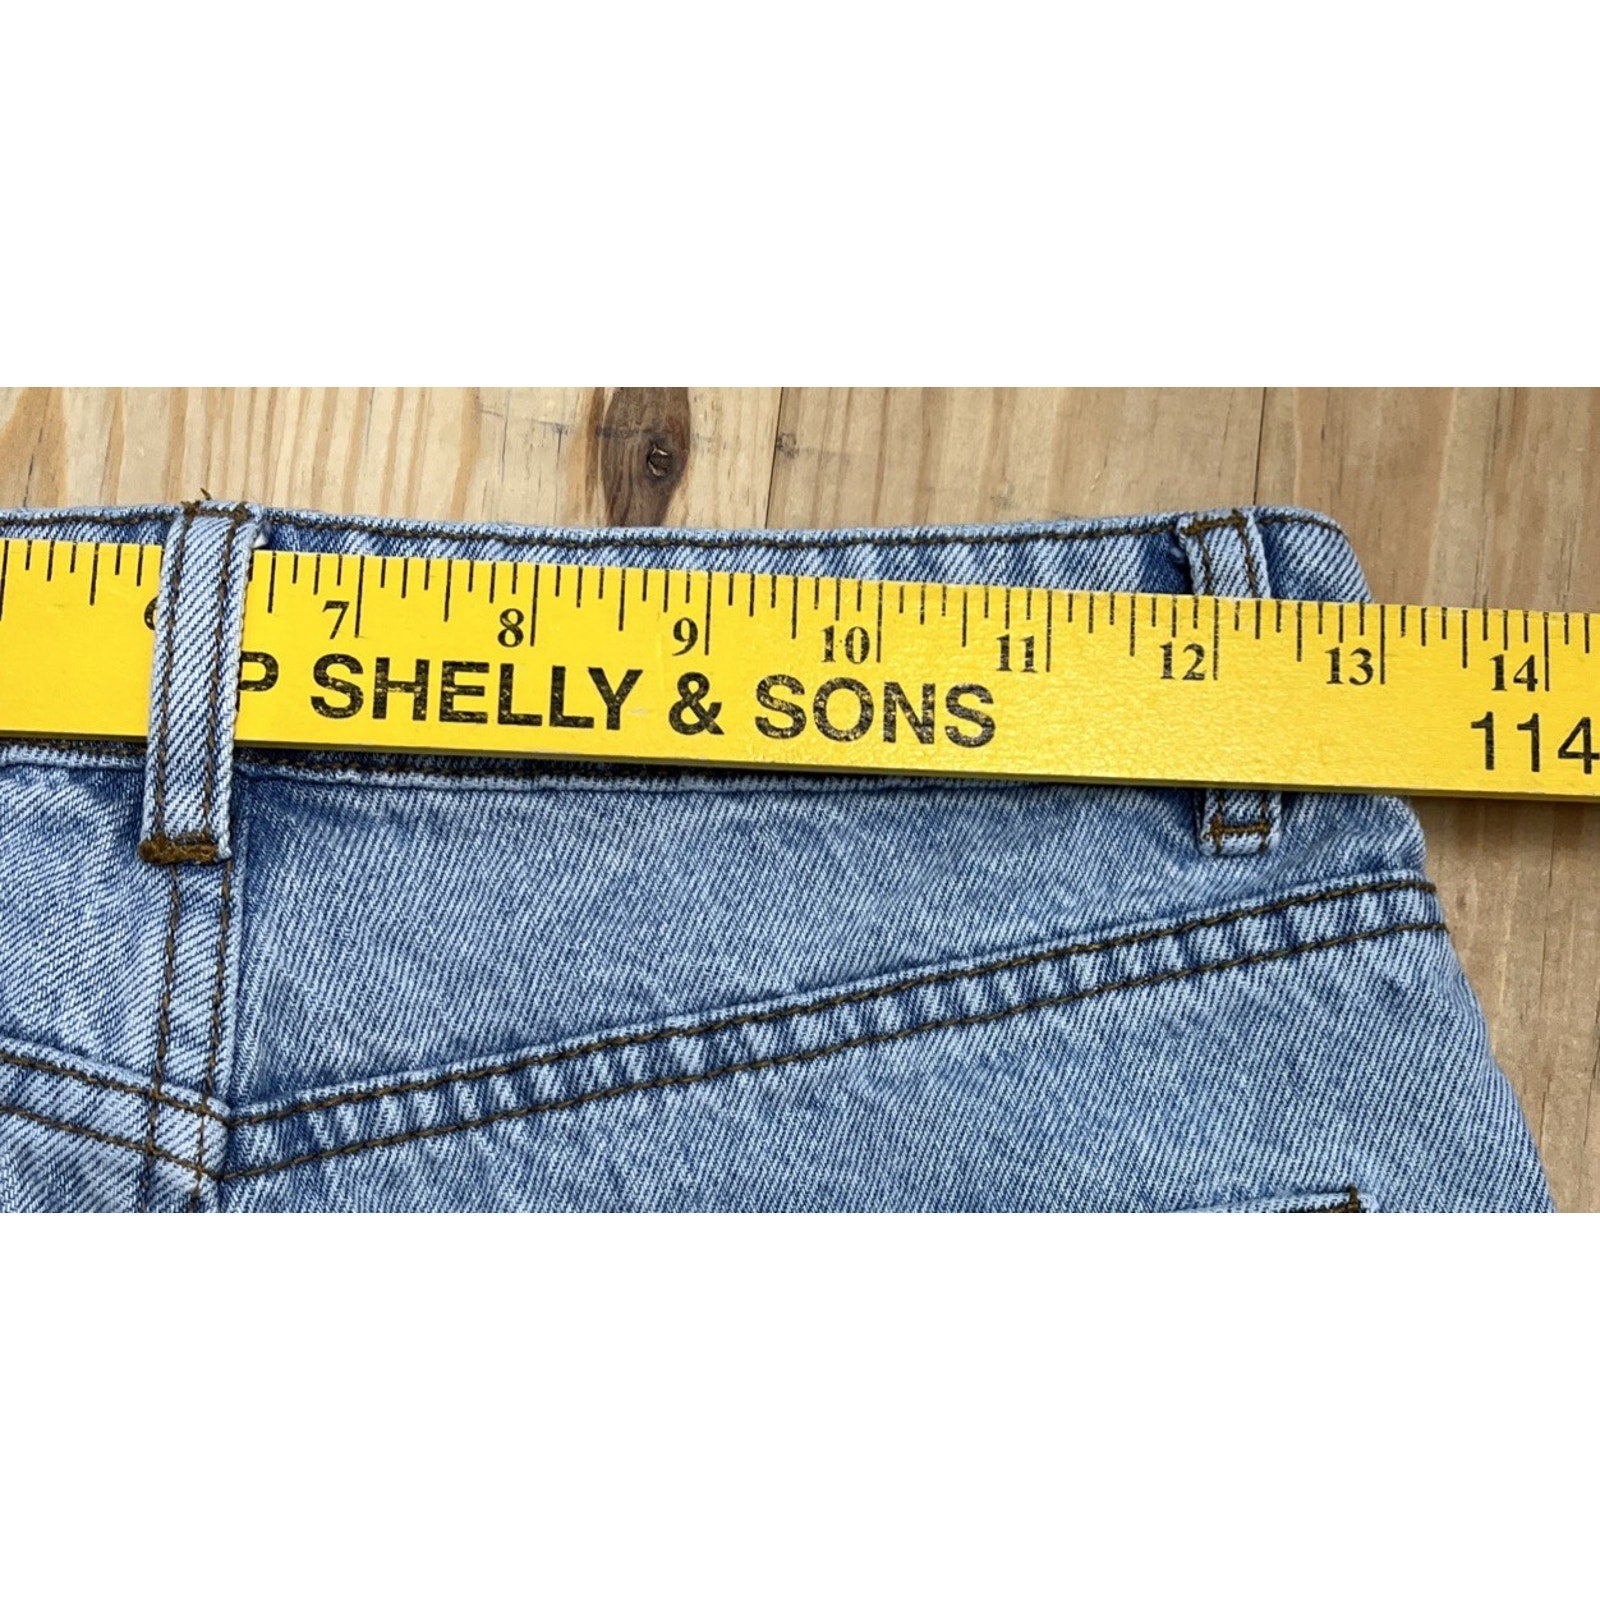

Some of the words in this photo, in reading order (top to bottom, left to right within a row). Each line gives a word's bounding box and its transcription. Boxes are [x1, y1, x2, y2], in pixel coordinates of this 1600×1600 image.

[322, 600, 350, 640] 7
[497, 608, 525, 648] 8
[672, 617, 699, 656] 9
[821, 625, 871, 664] 10
[996, 634, 1038, 674] 11
[1159, 642, 1207, 681] 12
[1325, 647, 1374, 686] 13
[1489, 654, 1539, 692] 14
[310, 651, 644, 732] SHELLY
[668, 672, 725, 736] &
[754, 674, 997, 748] SONS
[1470, 711, 1600, 775] 114
